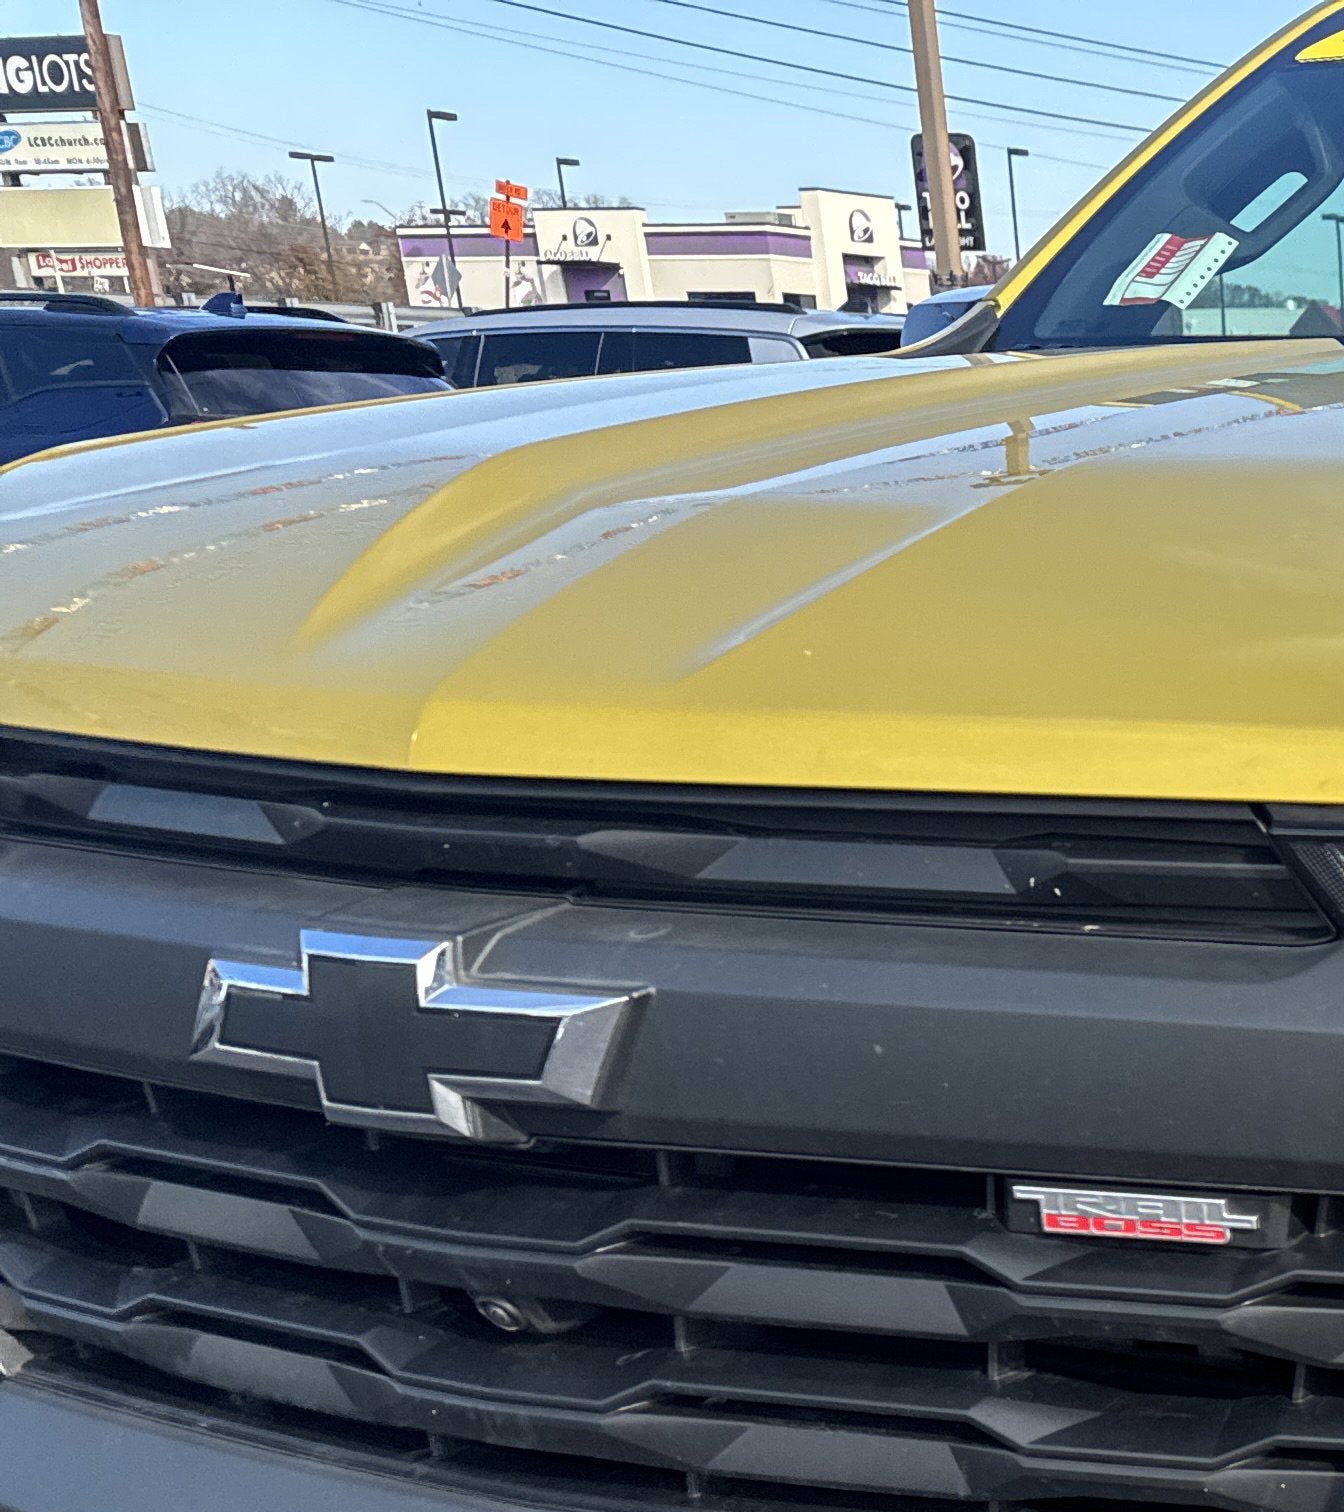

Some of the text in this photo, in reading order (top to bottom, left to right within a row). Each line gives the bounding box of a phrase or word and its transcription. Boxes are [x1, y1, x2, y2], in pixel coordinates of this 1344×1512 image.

[27, 134, 105, 148] LCBCchurch.co
[1012, 1185, 1260, 1229] TRAIL
[1043, 1212, 1231, 1244] BOSS
